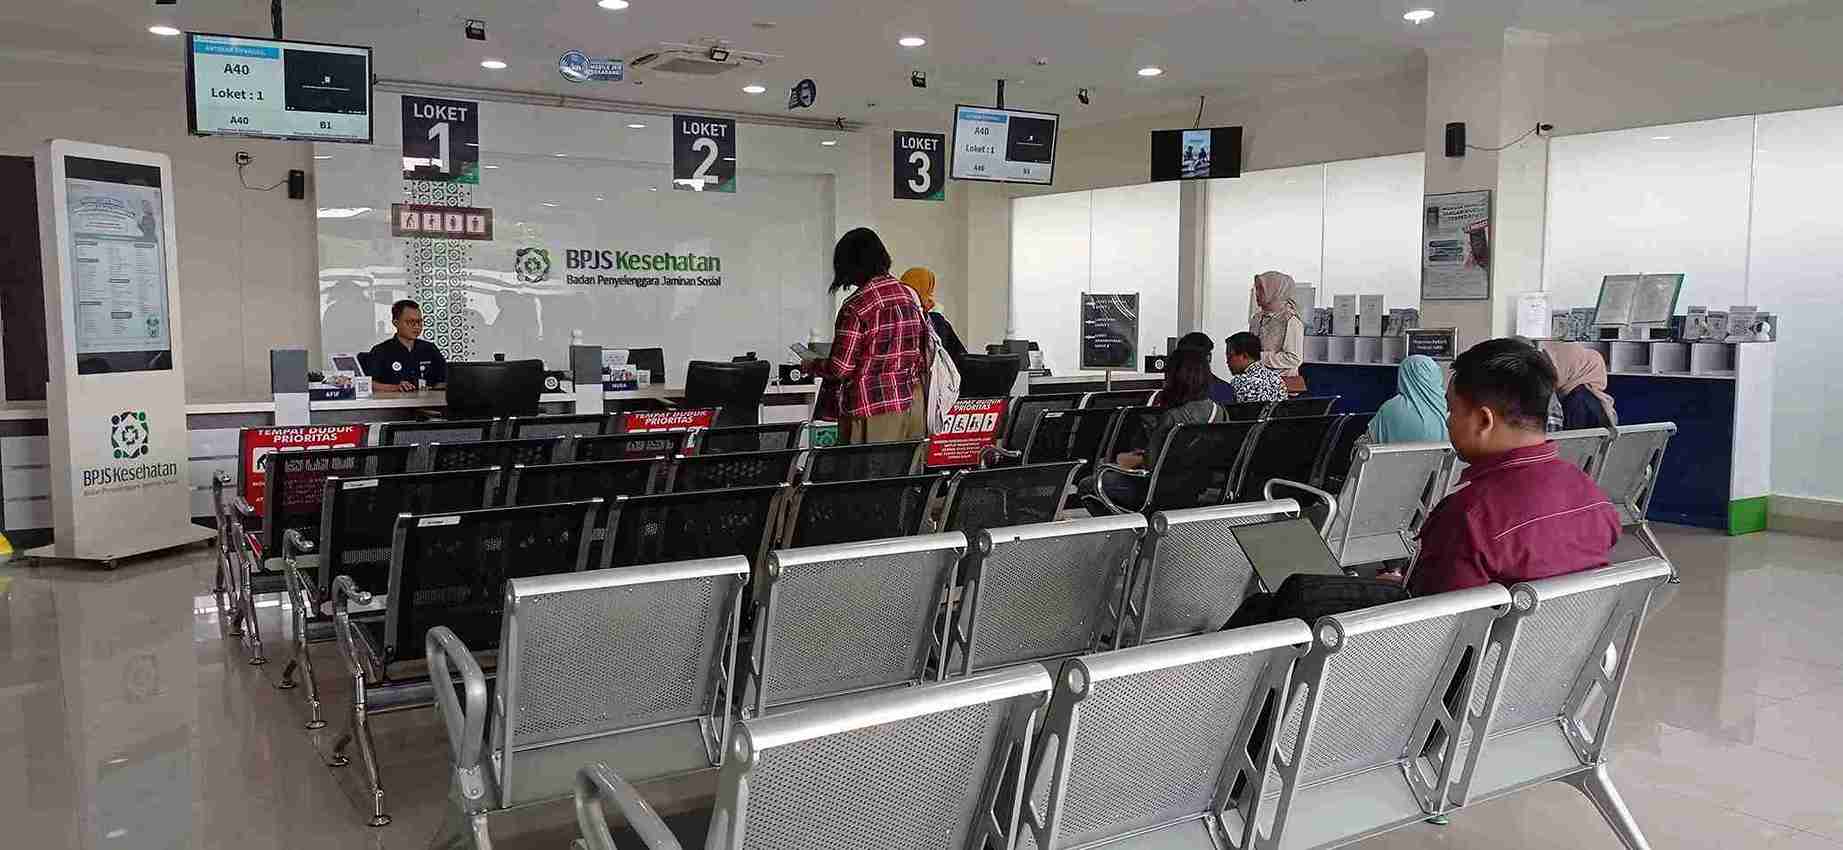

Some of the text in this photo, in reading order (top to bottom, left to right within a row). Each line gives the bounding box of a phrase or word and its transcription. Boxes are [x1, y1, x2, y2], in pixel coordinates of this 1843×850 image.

[223, 63, 250, 76] A40
[211, 88, 246, 100] Loket
[256, 91, 264, 101] 1
[413, 103, 468, 122] LOKET
[230, 116, 249, 125] A40
[682, 121, 728, 137] LOKET
[428, 122, 450, 173] 1
[901, 136, 938, 151] LOKET
[692, 137, 719, 184] 2
[908, 151, 931, 193] 3
[566, 249, 721, 272] BPJS Kesehatan
[566, 275, 721, 288] Badan Penyelenggara Jaminan Sosial
[644, 415, 695, 425] PRIORITAS
[258, 425, 353, 436] TEMPAT DUDUK
[273, 432, 338, 443] PRIORITAS
[83, 463, 177, 487] BPJS Kesehatan
